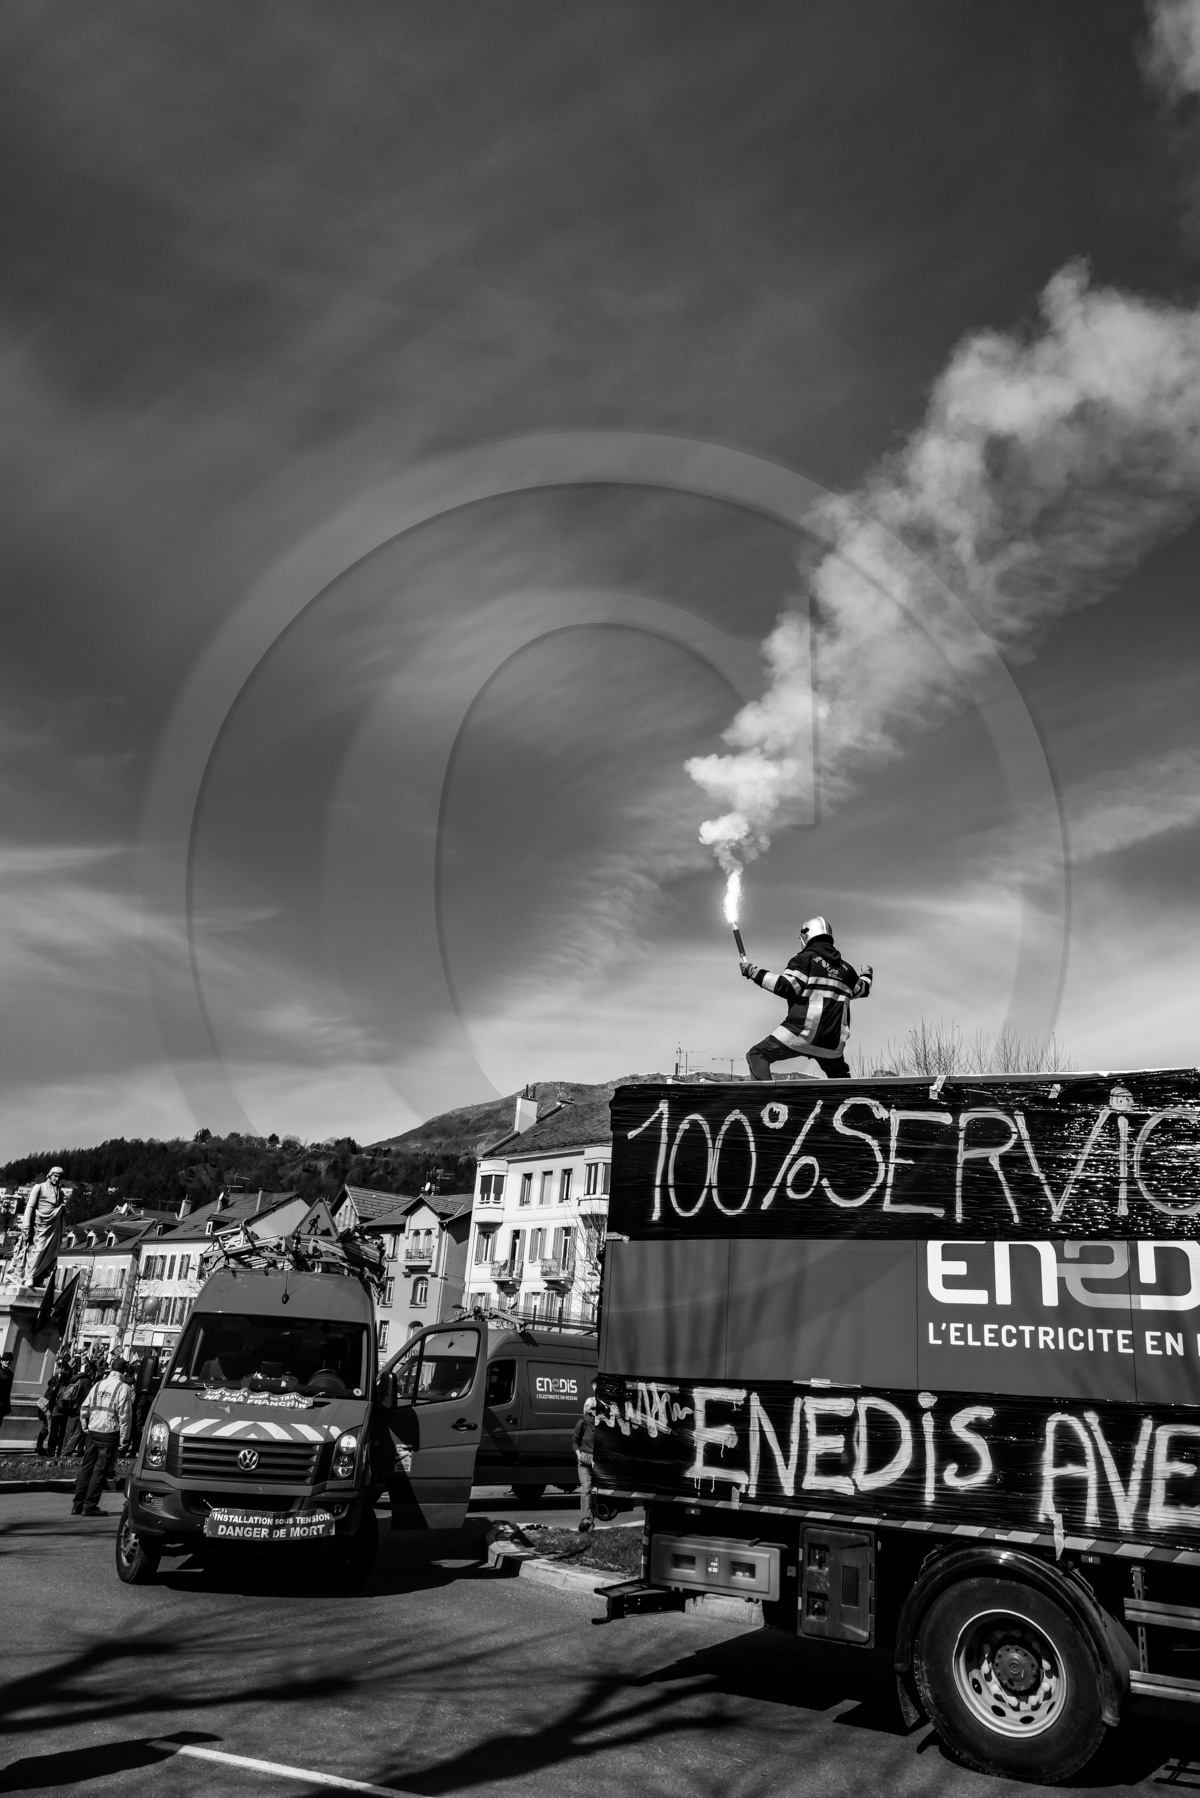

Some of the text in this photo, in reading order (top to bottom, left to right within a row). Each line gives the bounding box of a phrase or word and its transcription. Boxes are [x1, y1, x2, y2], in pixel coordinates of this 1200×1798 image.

[627, 1099, 823, 1221] 100%
[928, 1322, 1134, 1354] L'ELECTRICITE
[1145, 1331, 1185, 1357] EN
[246, 1399, 307, 1408] FRANCHIR
[213, 1512, 273, 1525] INSTALLATION
[296, 1513, 330, 1524] TENSION
[218, 1524, 325, 1538] DANGER DE MORT
